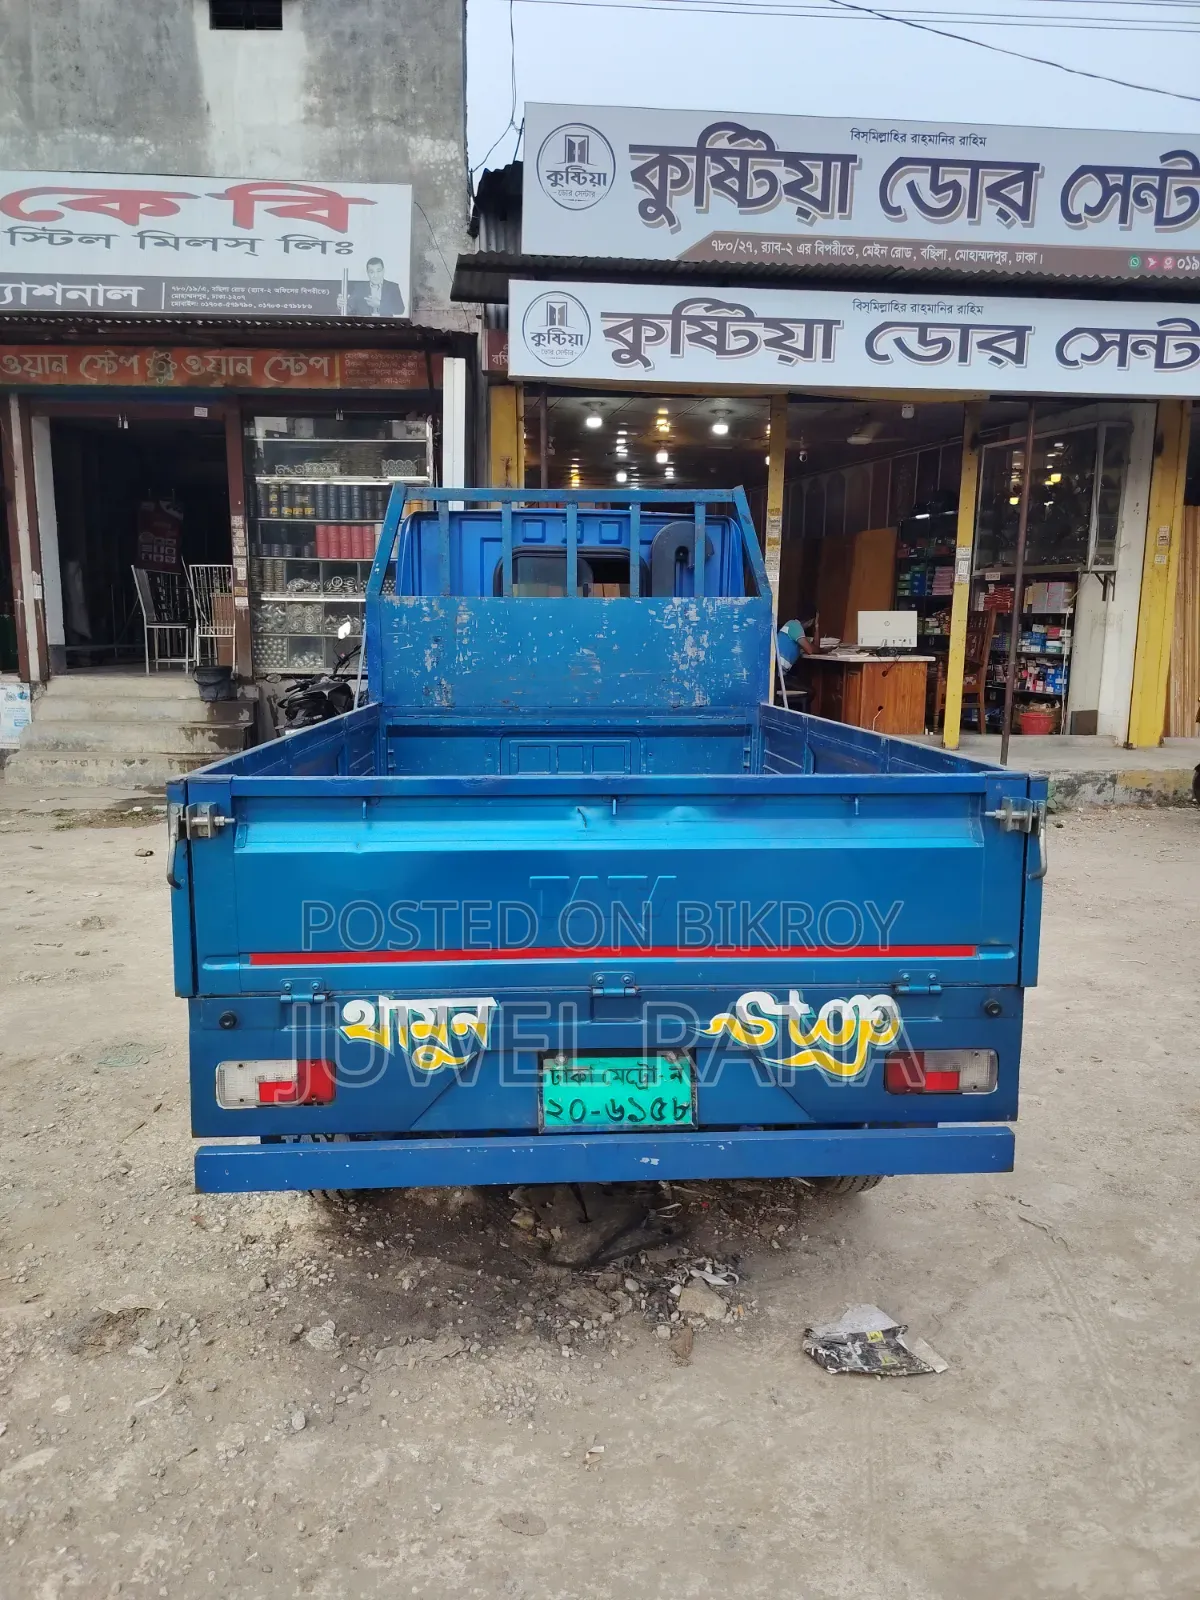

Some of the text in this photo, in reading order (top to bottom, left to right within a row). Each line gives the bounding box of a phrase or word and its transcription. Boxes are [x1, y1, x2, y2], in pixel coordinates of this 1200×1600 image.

[959, 133, 987, 147] রাহিম
[546, 165, 607, 187] কুষ্টিয়া
[628, 121, 1200, 232] কুষ্টিয়া ডোর সেন্ট
[0, 181, 378, 234] কে বি
[3, 226, 354, 257] স্টিল মিলস্ লিঃ
[711, 238, 758, 255] ৭৮০/২৭,
[796, 243, 811, 256] এর
[814, 240, 859, 259] বিপরীতে,
[862, 242, 888, 259] মেইন
[890, 246, 917, 261] রোড,
[920, 245, 951, 262] বছিলা,
[955, 249, 1012, 266] মোহাম্মদপুর,
[1177, 255, 1200, 270] ০১৯
[0, 281, 145, 307] ্যাশনাল
[957, 303, 984, 316] রাহিম
[530, 328, 584, 347] কুষ্টিয়া
[600, 297, 1200, 371] কুষ্টিয়া ডোর সেন্ট
[0, 354, 68, 378] ওয়ান
[79, 351, 140, 381] স্টেপ
[264, 352, 331, 382] স্টেপ
[339, 995, 501, 1071] থামুন
[549, 1064, 594, 1086] ঢাকা
[546, 1097, 690, 1123] ২০-৬১৫৮
